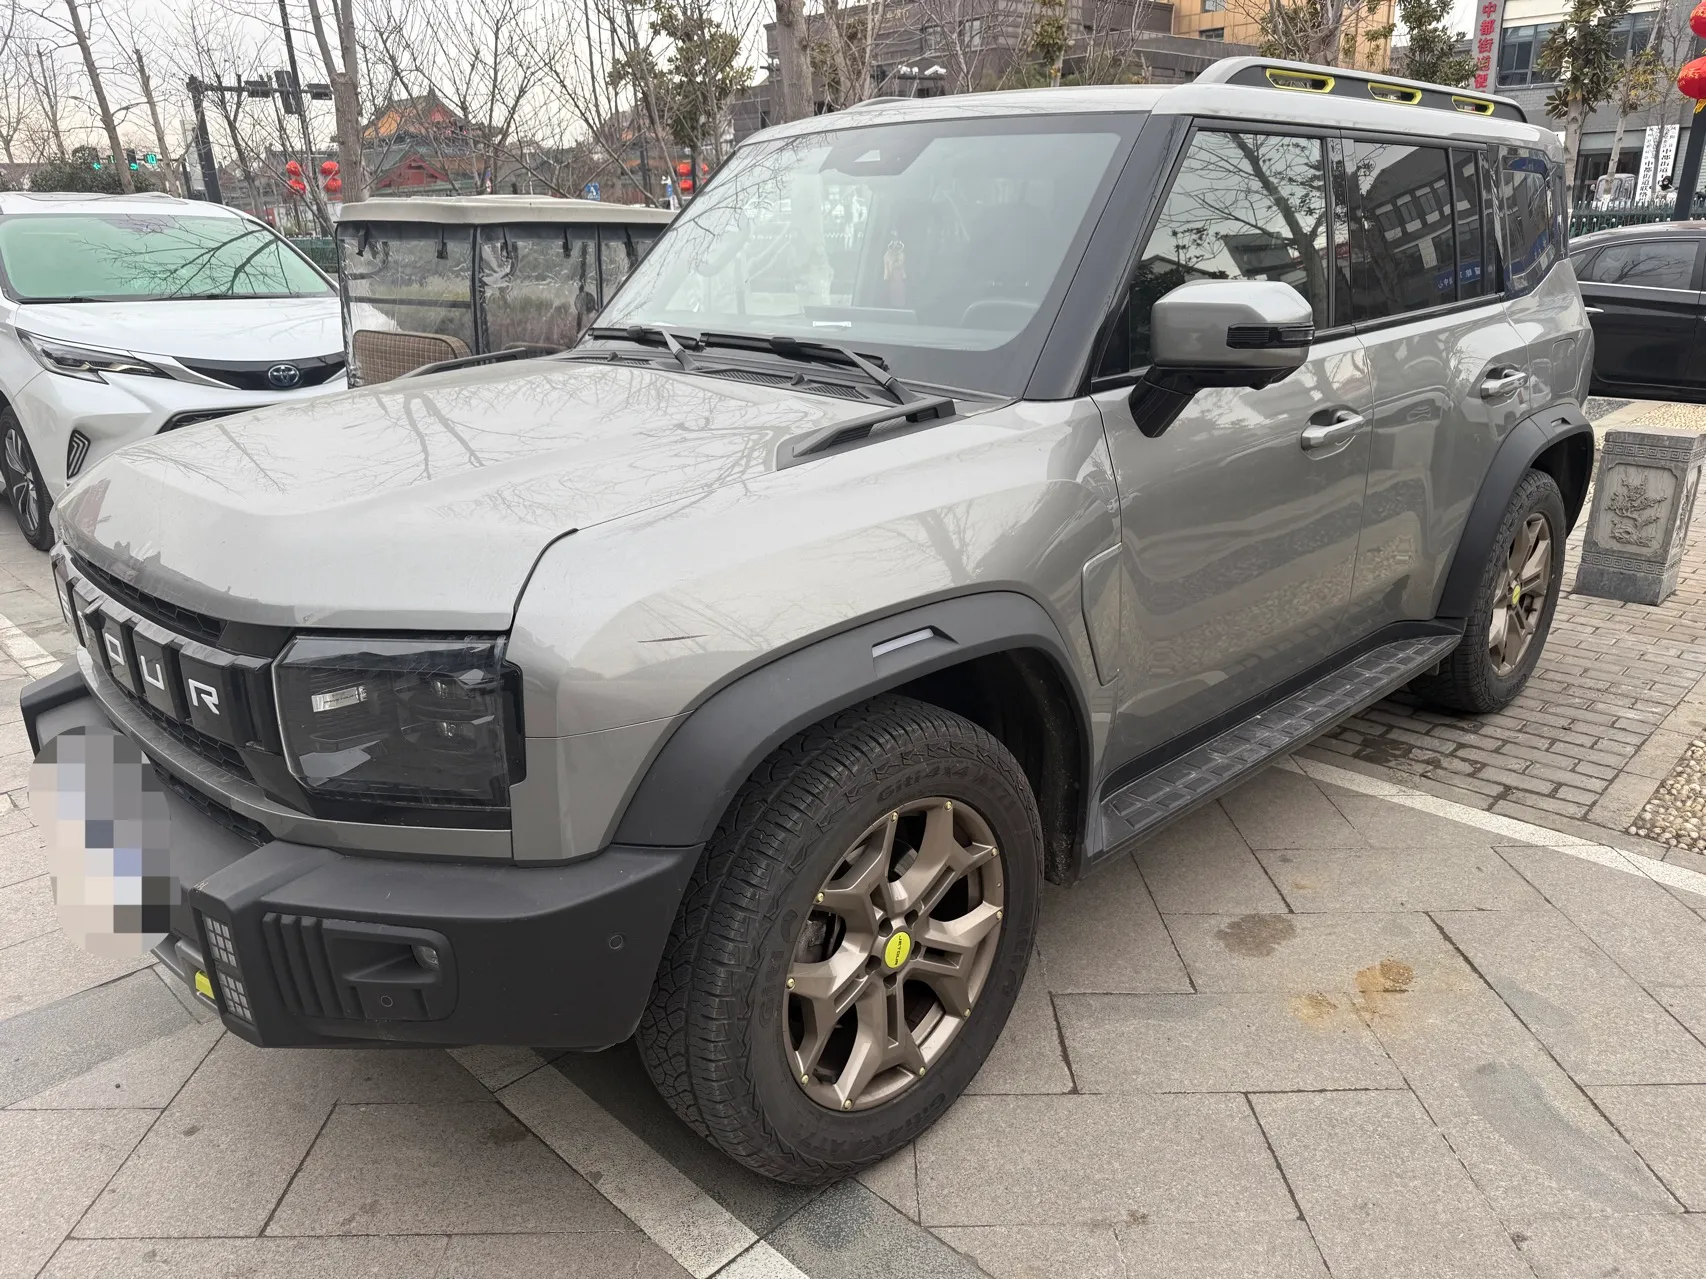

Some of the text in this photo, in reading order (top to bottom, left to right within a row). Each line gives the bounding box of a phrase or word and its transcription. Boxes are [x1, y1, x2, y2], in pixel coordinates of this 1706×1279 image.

[1474, 1, 1498, 93] 中都街道便
